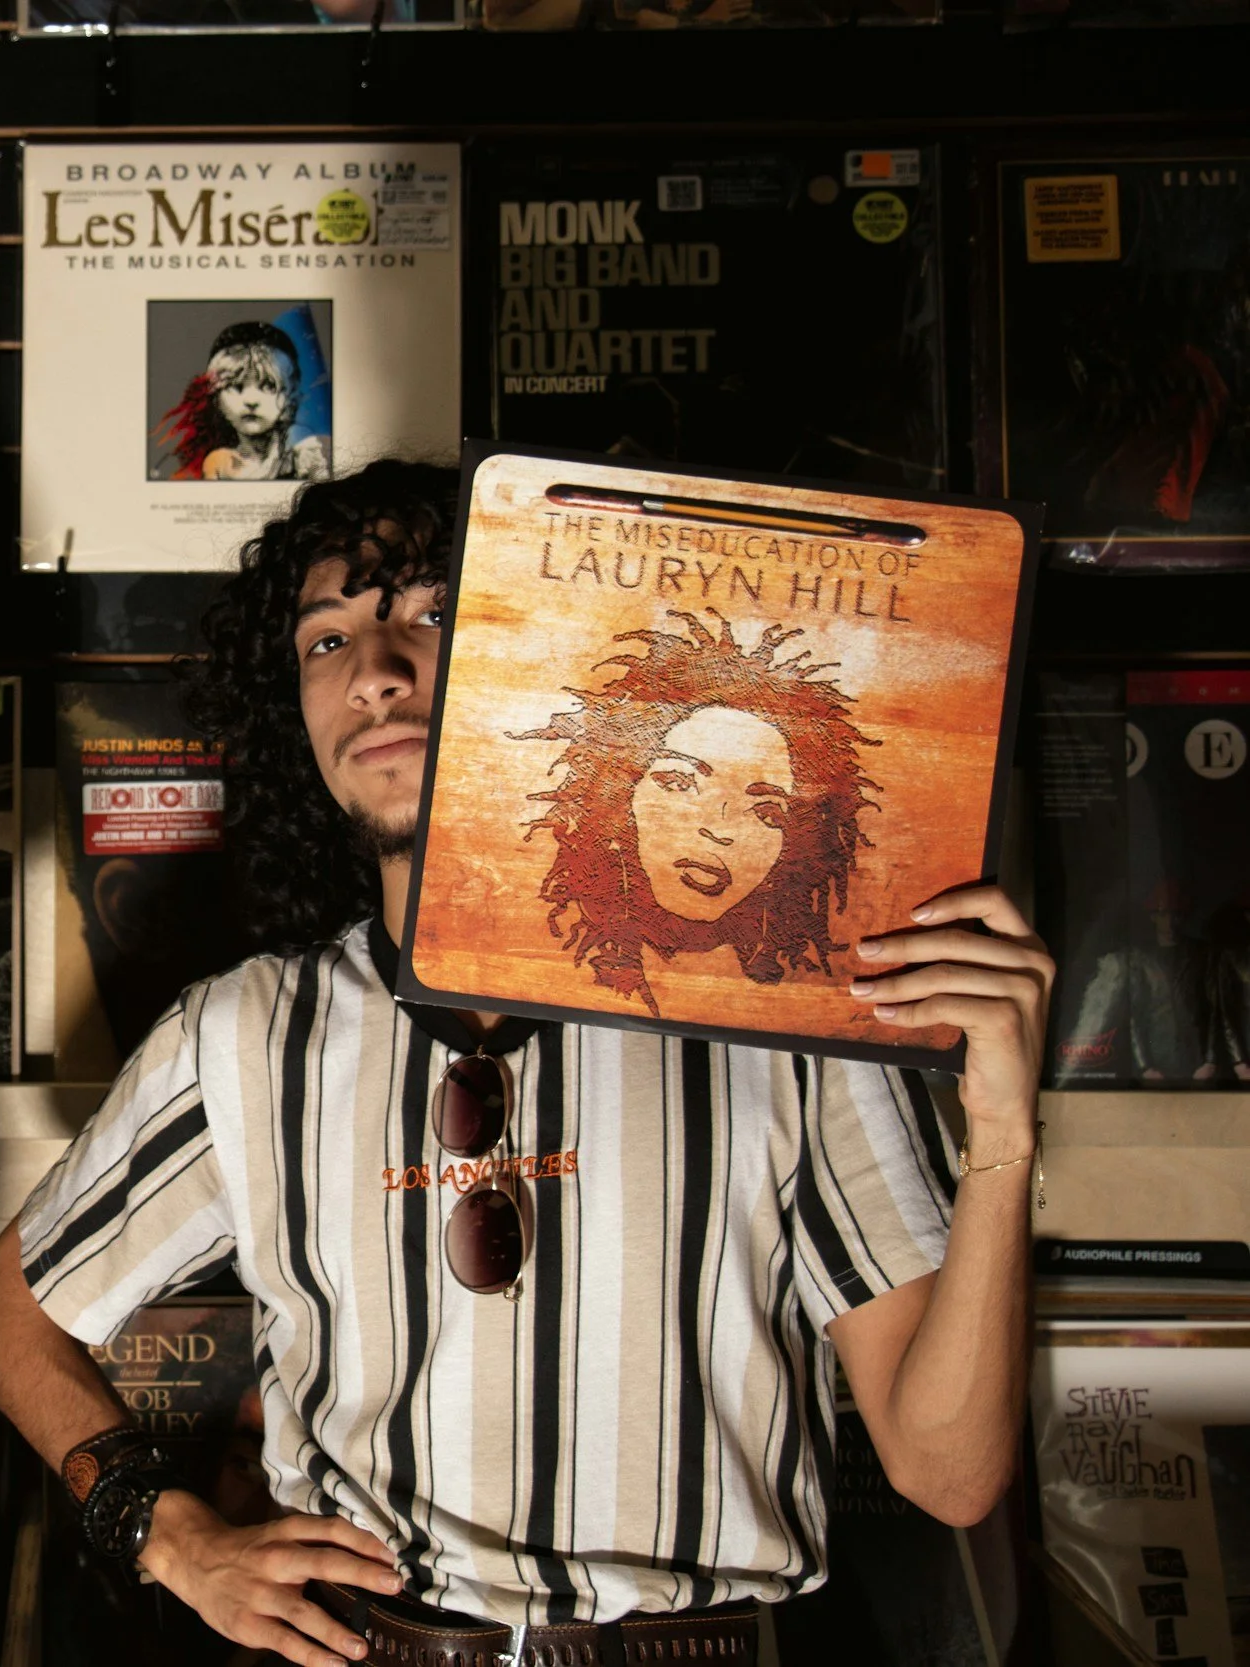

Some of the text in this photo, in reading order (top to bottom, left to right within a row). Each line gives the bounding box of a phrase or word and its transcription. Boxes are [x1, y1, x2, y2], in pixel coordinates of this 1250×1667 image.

[66, 162, 417, 182] BROADWAY ALBUM
[41, 189, 137, 250] Les
[499, 199, 645, 246] MONK
[65, 254, 416, 270] THE MUSICAL SENSATION
[500, 241, 721, 290] BIG BAND
[500, 287, 601, 333] AND
[499, 328, 718, 377] QUARTET
[504, 374, 609, 394] IN CONCERT
[544, 511, 921, 579] THE MISEDUCATION OF
[538, 541, 913, 625] LAURYN HILL
[82, 738, 133, 753] JUSTIN
[137, 737, 184, 752] HINDS
[1201, 732, 1235, 768] E
[91, 788, 144, 810] RECORD
[148, 786, 194, 808] STORE
[381, 1164, 430, 1192] LOS
[1063, 1249, 1203, 1263] AUDIOPHILE PRESSINGS
[87, 1334, 216, 1363] EGEND
[131, 1412, 203, 1434] RLEY
